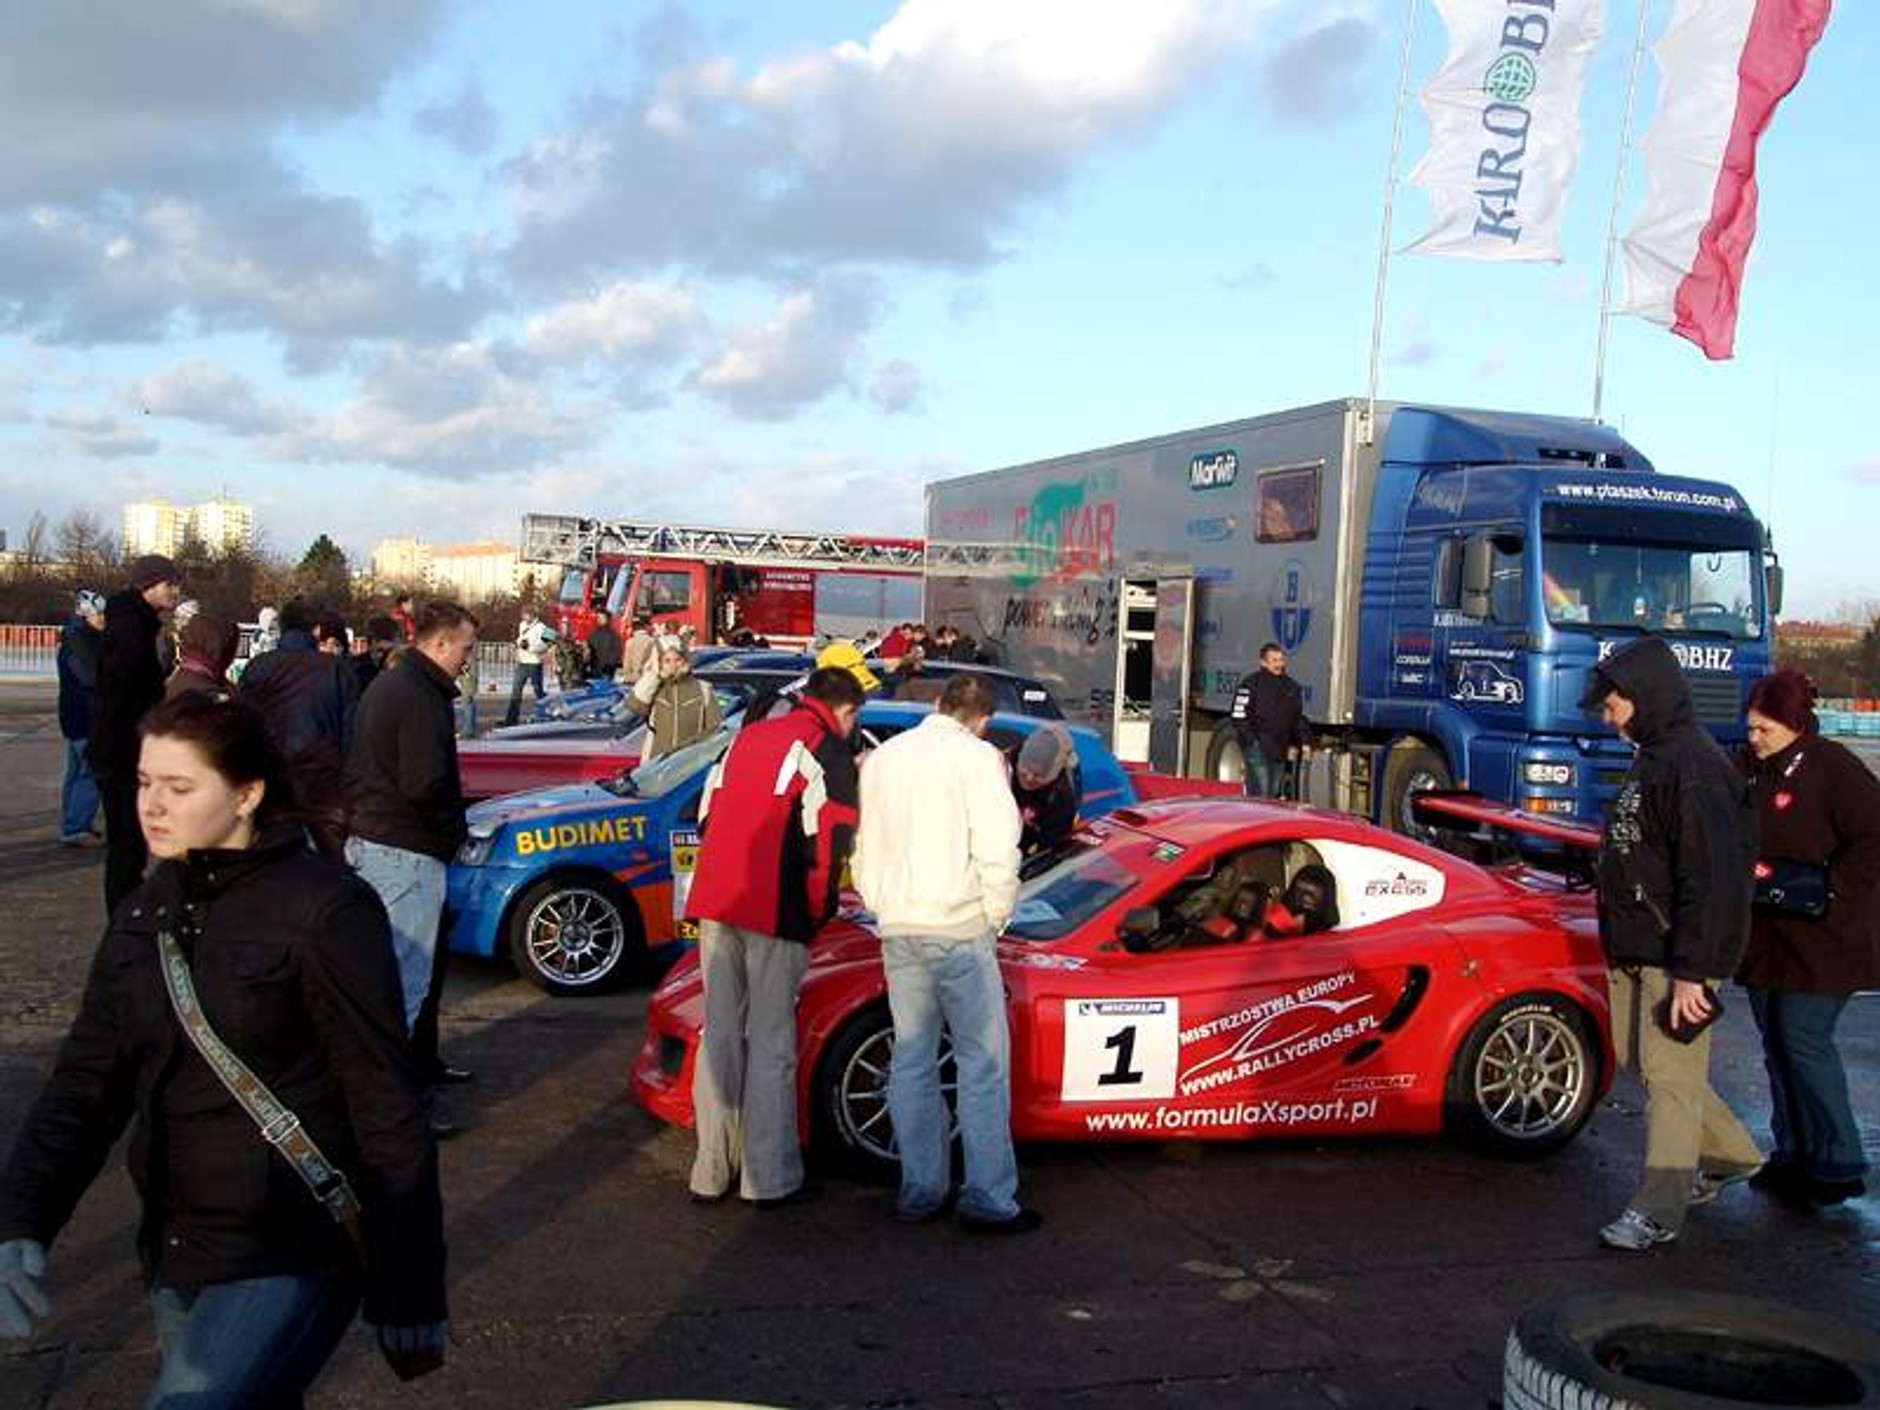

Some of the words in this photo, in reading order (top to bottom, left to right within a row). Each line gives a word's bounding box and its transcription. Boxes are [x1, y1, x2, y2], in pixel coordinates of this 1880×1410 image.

[516, 816, 648, 856] BUDIMET
[1179, 996, 1296, 1047] MISTRZOSTWA
[1297, 970, 1356, 1004] EUROPY
[1097, 1024, 1144, 1087] 1
[1180, 1014, 1382, 1097] WWW.RALLYCROSS.PL
[1085, 1097, 1378, 1133] www.formulaXsport.pl
